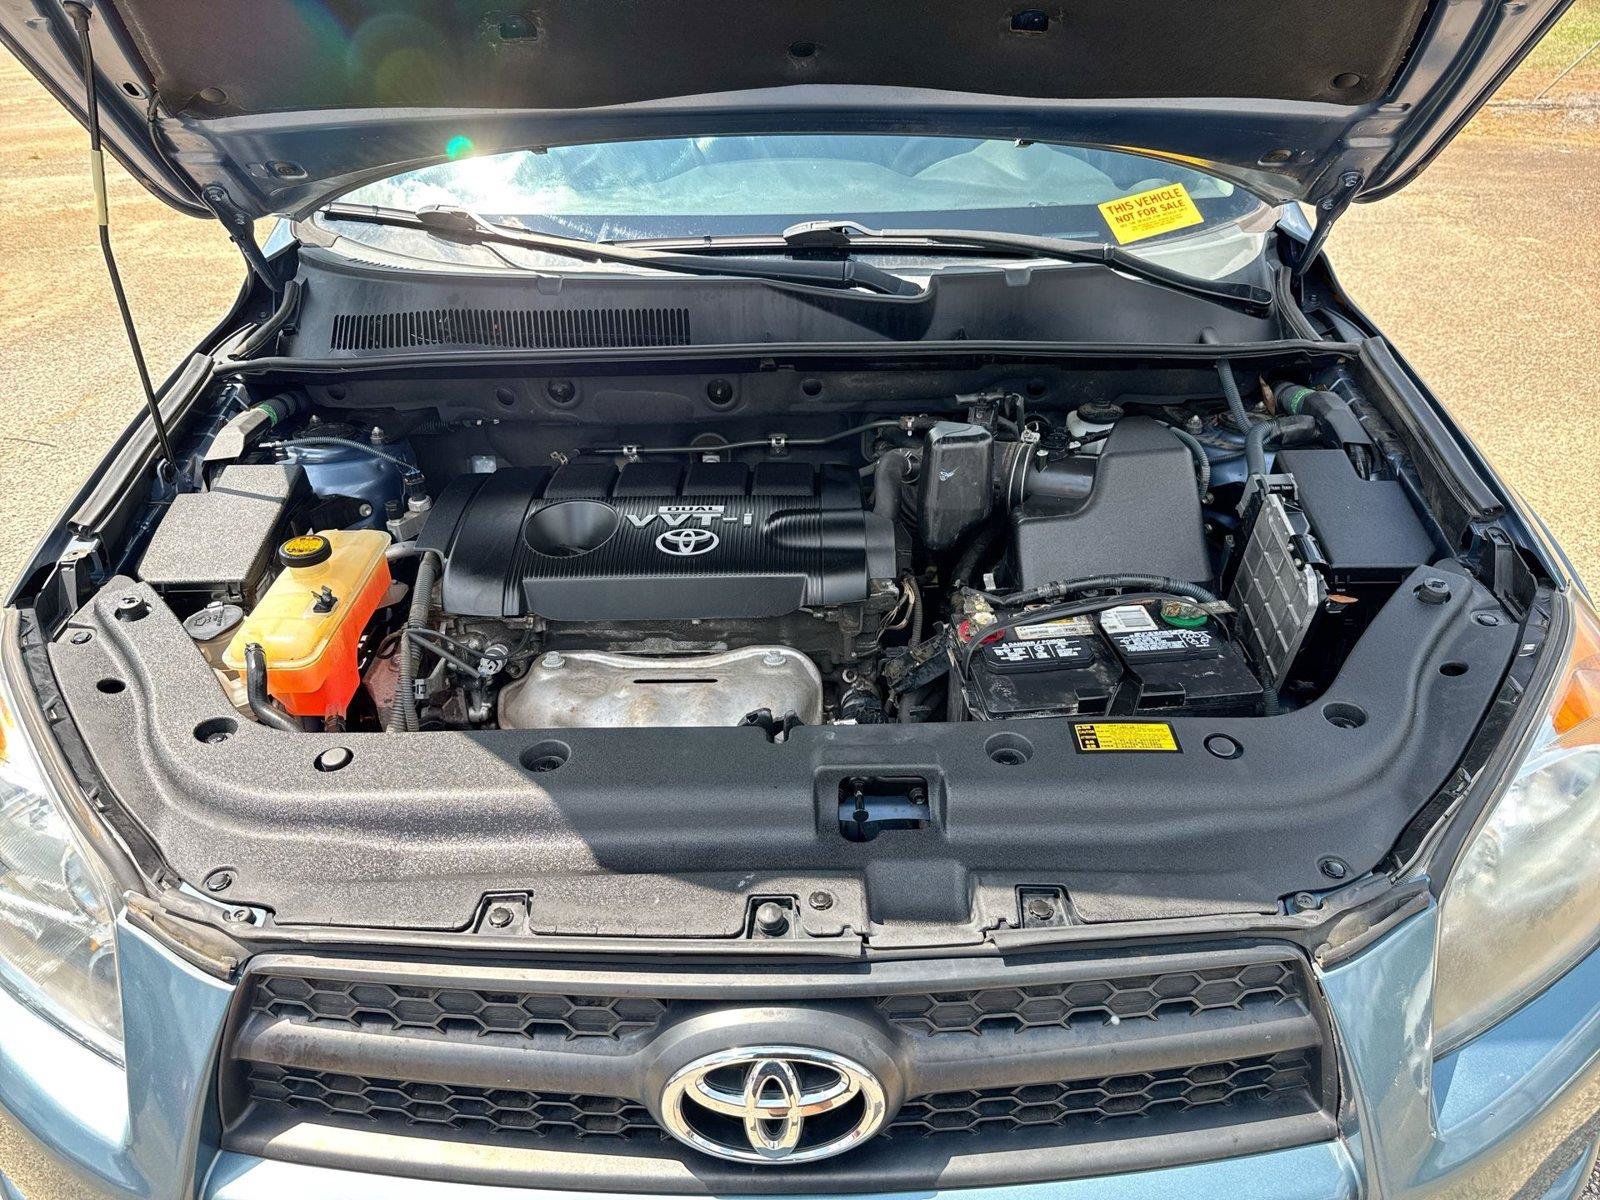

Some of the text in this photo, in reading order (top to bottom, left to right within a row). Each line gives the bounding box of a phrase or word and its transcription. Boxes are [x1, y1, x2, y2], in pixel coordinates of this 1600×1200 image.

[1106, 188, 1183, 215] THIS VEHICLE
[1115, 212, 1136, 224] NOT
[1137, 206, 1158, 218] FOR
[1160, 200, 1186, 212] SALE
[626, 512, 752, 527] VVT-i
